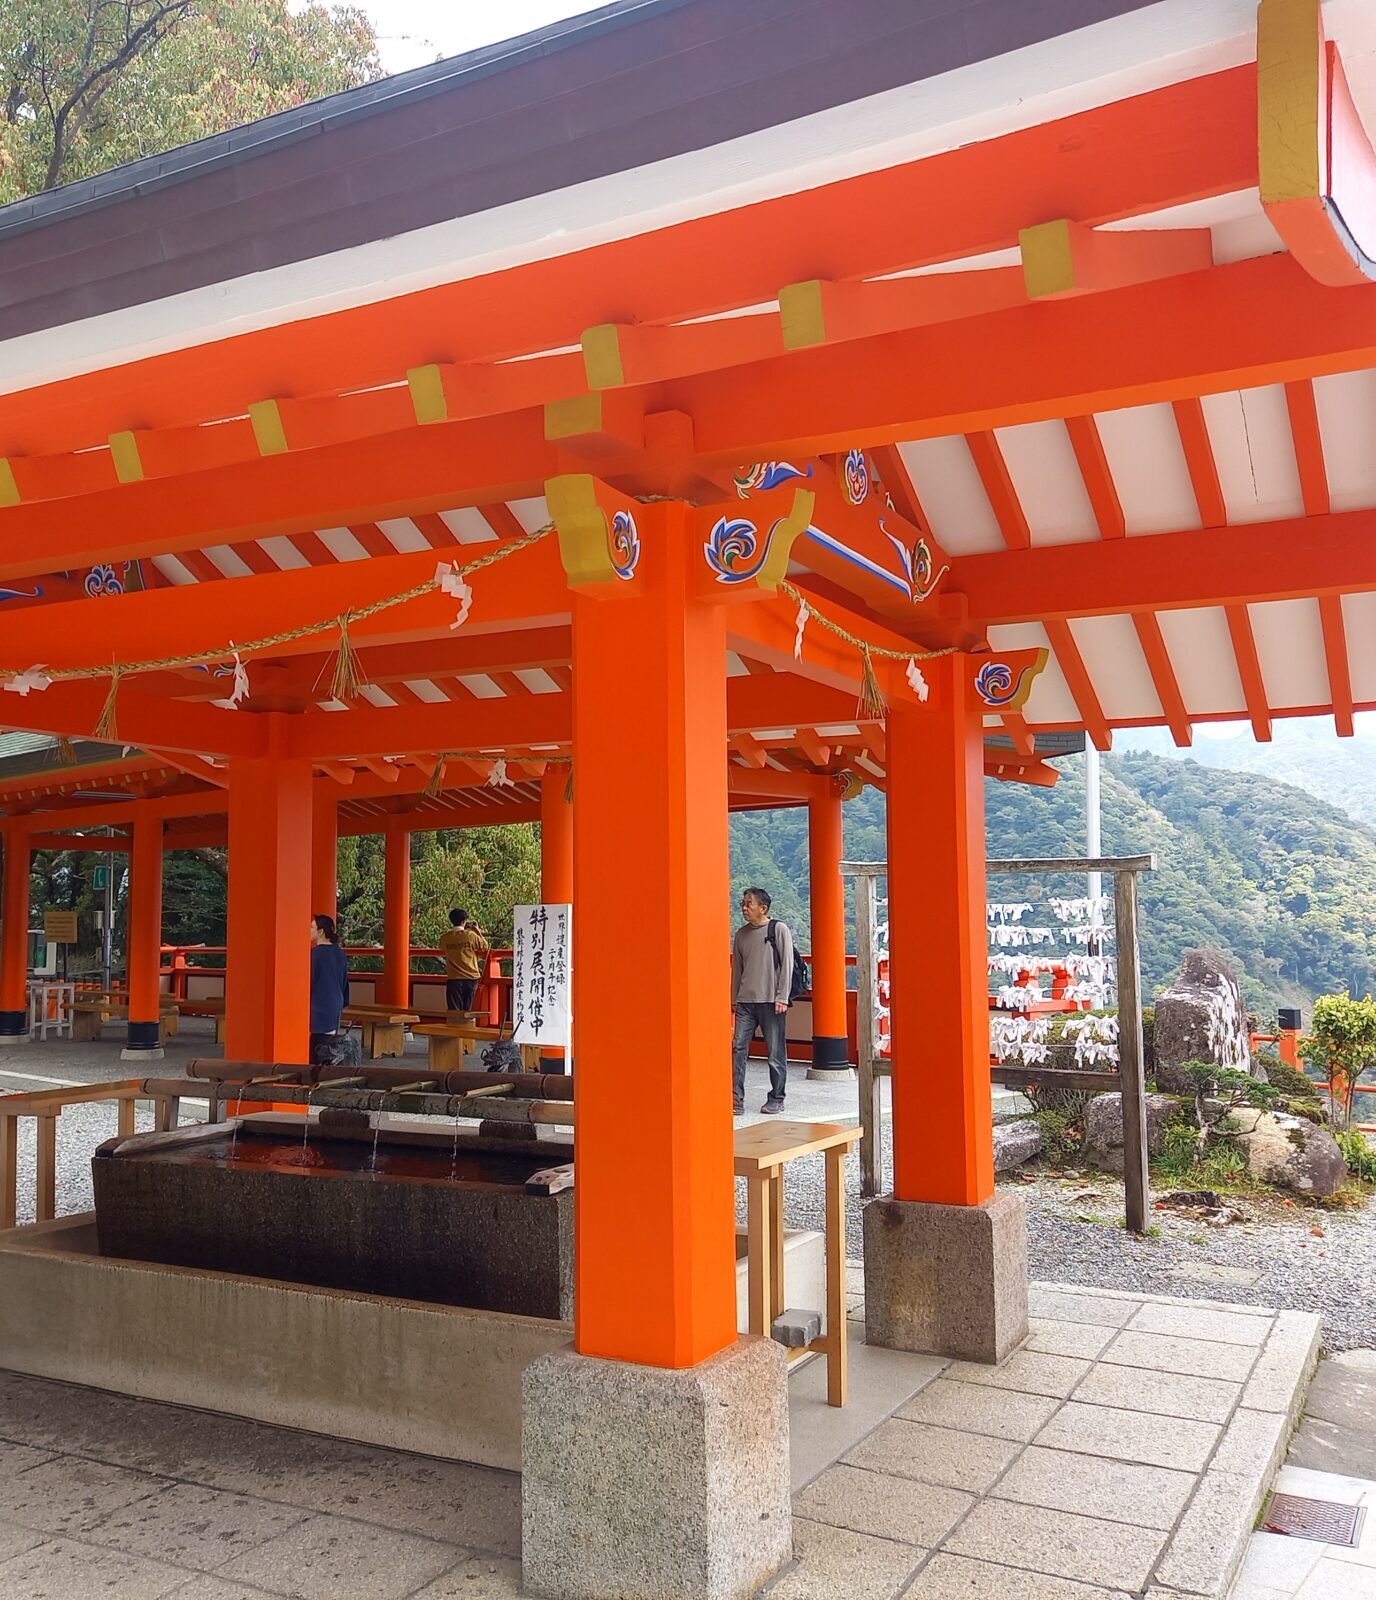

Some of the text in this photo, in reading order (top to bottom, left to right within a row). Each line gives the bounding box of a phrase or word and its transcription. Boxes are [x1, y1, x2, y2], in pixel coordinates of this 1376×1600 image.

[528, 905, 549, 1037] 特別展開催中
